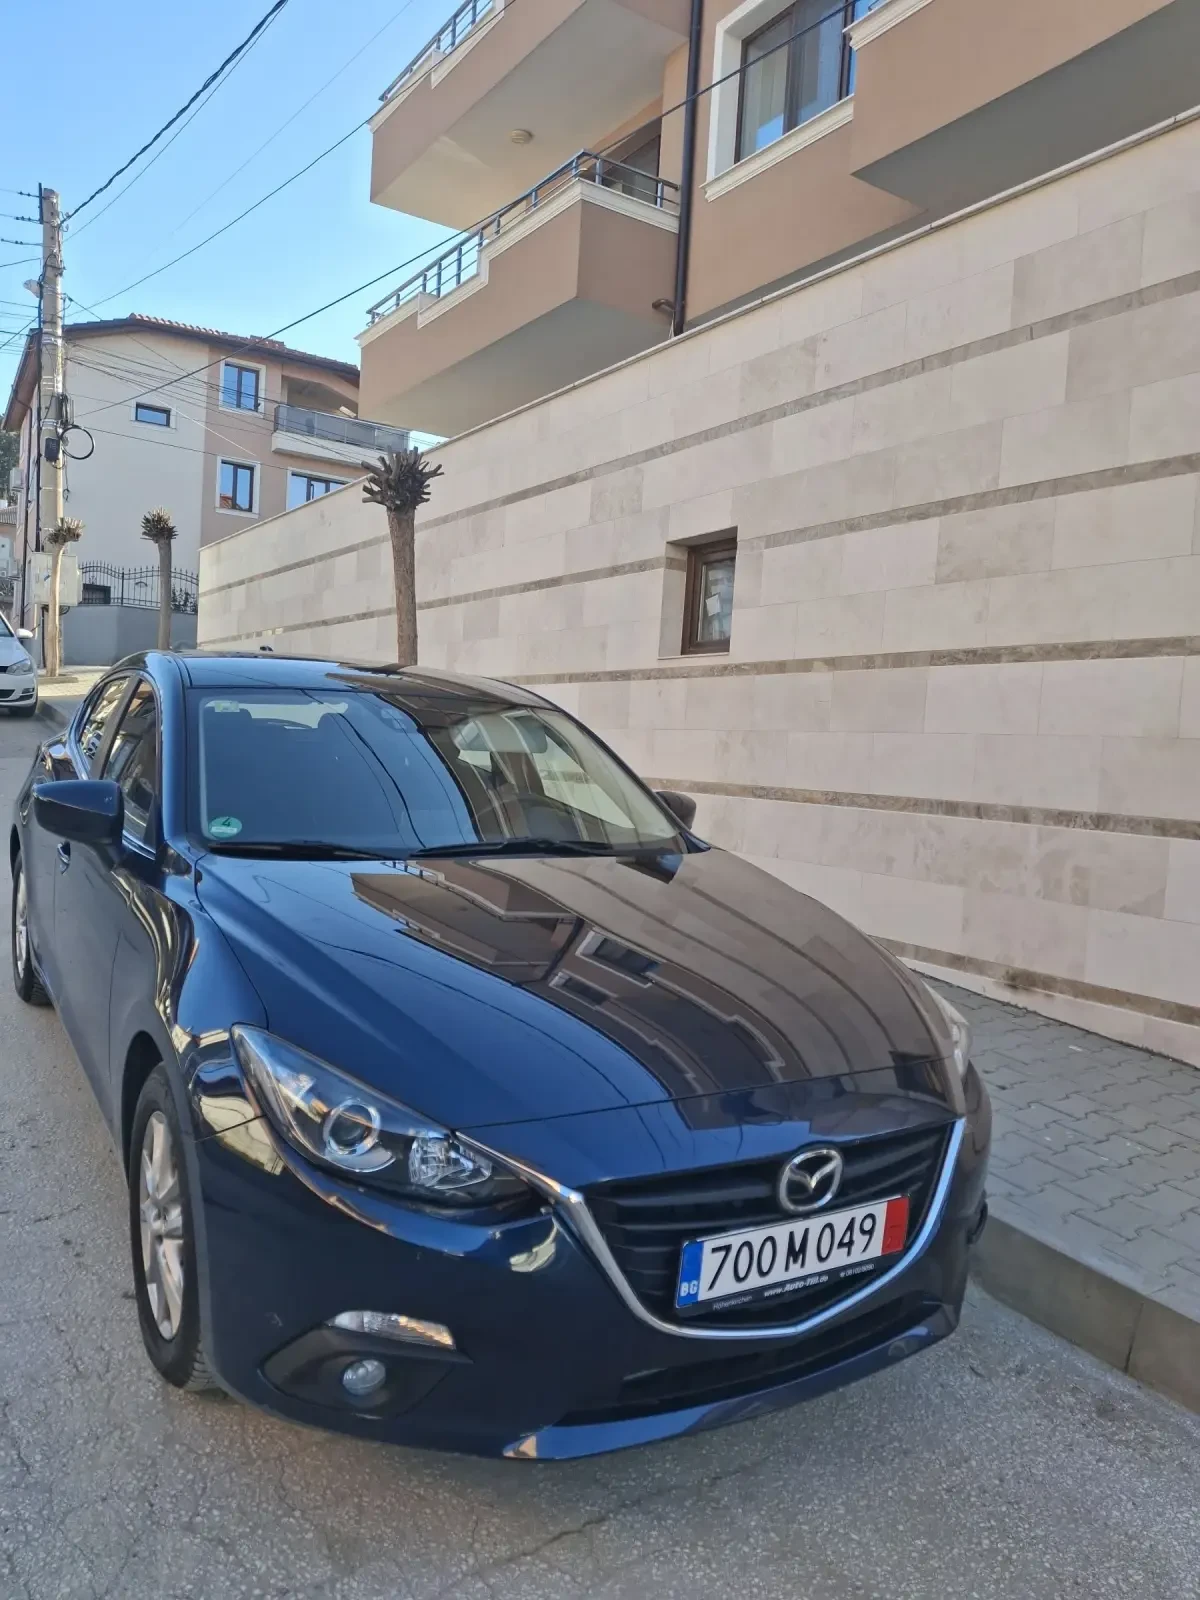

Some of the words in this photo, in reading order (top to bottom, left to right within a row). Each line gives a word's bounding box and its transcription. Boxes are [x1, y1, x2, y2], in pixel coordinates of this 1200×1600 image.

[221, 817, 232, 827] 4
[706, 1235, 777, 1292] 700
[784, 1227, 810, 1272] M
[816, 1212, 878, 1263] 049
[679, 1280, 699, 1297] BG
